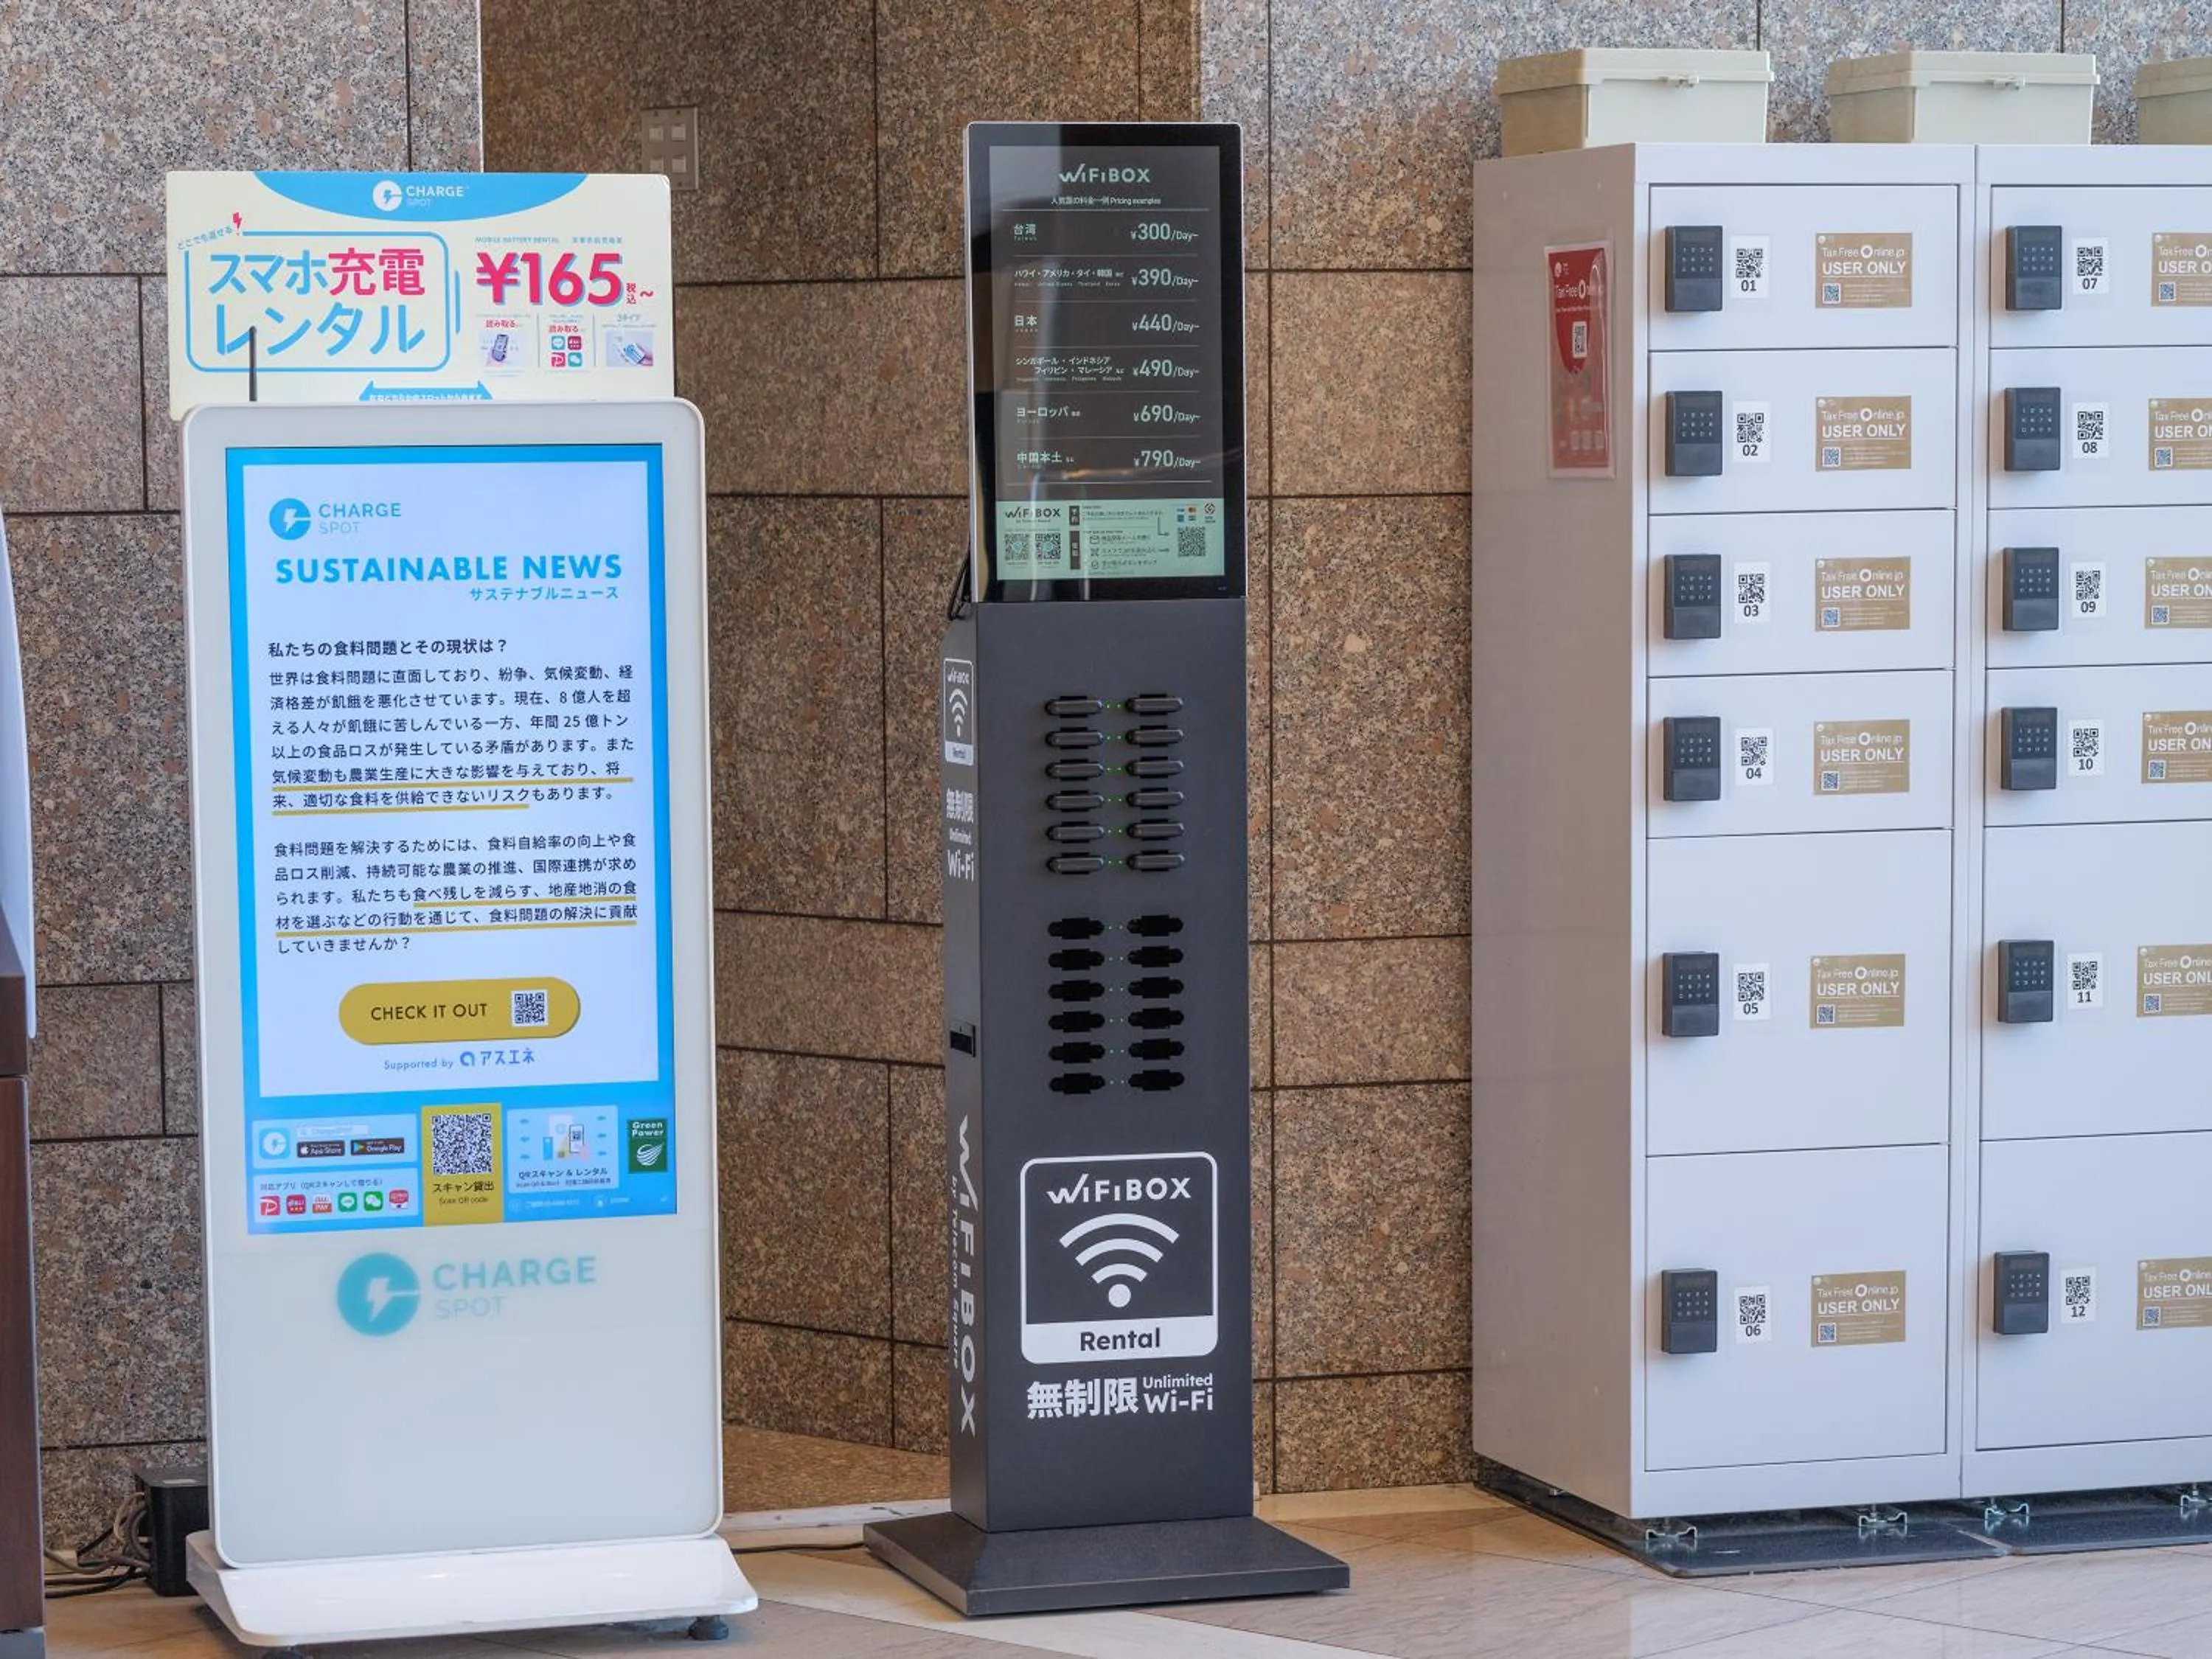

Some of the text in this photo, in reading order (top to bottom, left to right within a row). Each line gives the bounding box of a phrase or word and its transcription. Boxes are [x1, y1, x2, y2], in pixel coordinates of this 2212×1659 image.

[406, 186, 465, 197] CHARGE
[1014, 223, 1036, 235] 台湾
[208, 248, 425, 295] スマホ充電
[1823, 261, 1906, 274] USER ONLY
[2158, 261, 2197, 274] USER
[476, 251, 623, 307] ¥165
[1741, 280, 1756, 292] 01
[2082, 279, 2098, 290] 07
[1015, 315, 1037, 326] 日本
[215, 302, 424, 355] レンタル
[1017, 406, 1069, 418] ヨーロッパ
[1822, 425, 1905, 439] USER ONLY
[2154, 425, 2193, 439] USER
[1742, 445, 1758, 456] 02
[2082, 442, 2097, 453] 08
[1017, 451, 1062, 464] 中国本土
[319, 503, 402, 518] CHARGE
[1006, 507, 1060, 518] WiFBOX
[319, 522, 360, 535] SPOT
[276, 554, 622, 584] SUSTAINABLE NEWS
[470, 586, 619, 602] サステナブルニュース
[1821, 585, 1905, 599] USER ONLY
[2152, 585, 2212, 597] USER ON
[1743, 605, 1759, 617] 03
[2080, 602, 2096, 613] 09
[2148, 738, 2212, 752] USER ON
[1820, 748, 1903, 763] USER ONLY
[2079, 759, 2093, 771] 10
[1746, 768, 1761, 779] 04
[947, 849, 974, 882] Wi-Fi
[2143, 971, 2212, 986] USER ONL
[1817, 982, 1899, 997] USER ONLY
[2077, 992, 2092, 1003] 11
[371, 1003, 487, 1021] CHECK IT OUT
[1743, 1003, 1759, 1015] 05
[481, 1048, 535, 1066] アスエネ
[384, 1058, 453, 1072] Supported by
[632, 1121, 663, 1130] Green
[632, 1129, 664, 1137] Power
[433, 1256, 597, 1290] CHARGE
[2143, 1284, 2212, 1299] USER ONL
[436, 1295, 507, 1320] SPOT
[1818, 1298, 1899, 1315] USER ONLY
[2071, 1306, 2085, 1318] 12
[1745, 1326, 1761, 1337] 06
[1080, 1327, 1160, 1351] Rental
[1143, 1373, 1213, 1389] Unlimited
[1027, 1377, 1139, 1420] 無制限
[1143, 1389, 1213, 1413] Wi-Fi
